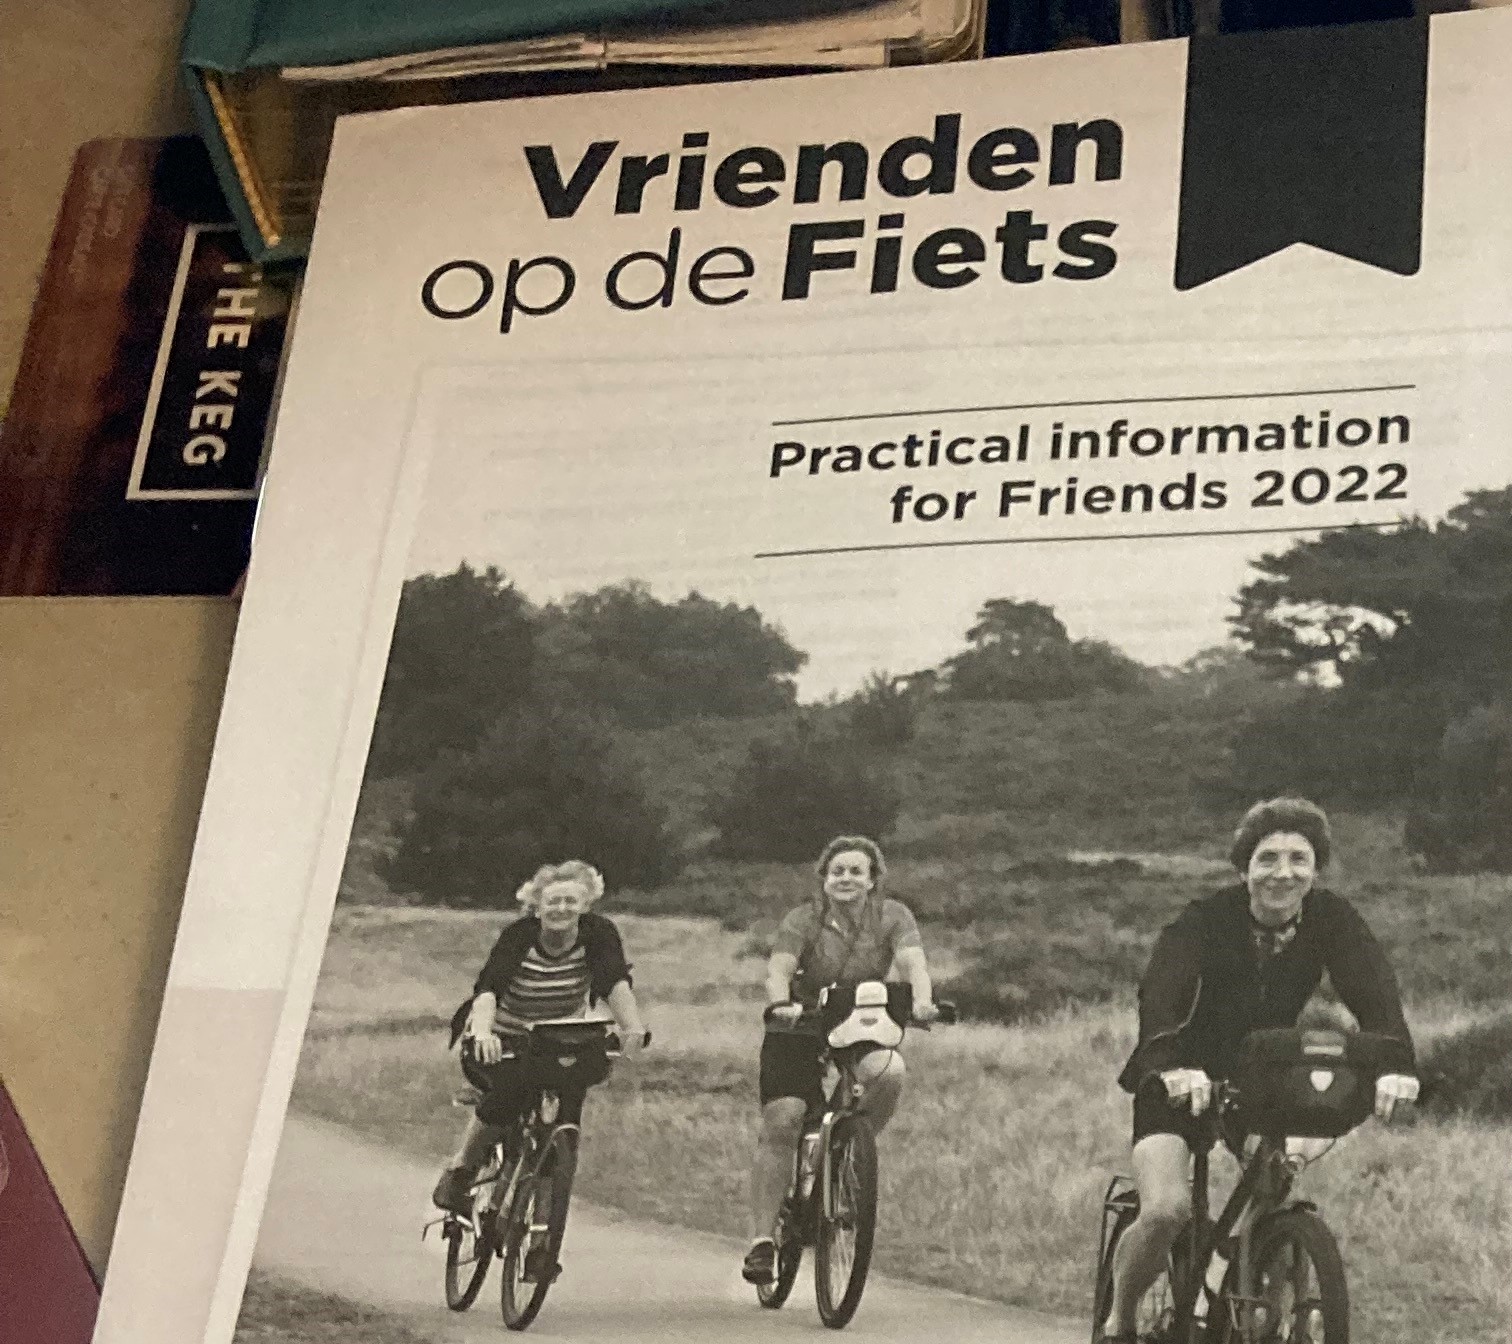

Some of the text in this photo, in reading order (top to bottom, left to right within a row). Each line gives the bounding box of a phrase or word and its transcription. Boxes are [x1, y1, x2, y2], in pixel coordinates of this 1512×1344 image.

[523, 113, 1123, 219] Vrienden
[422, 210, 1118, 334] op de Fiets
[183, 371, 242, 465] KEG
[770, 410, 1409, 477] Practical information
[890, 463, 1407, 523] for Friends 2022
